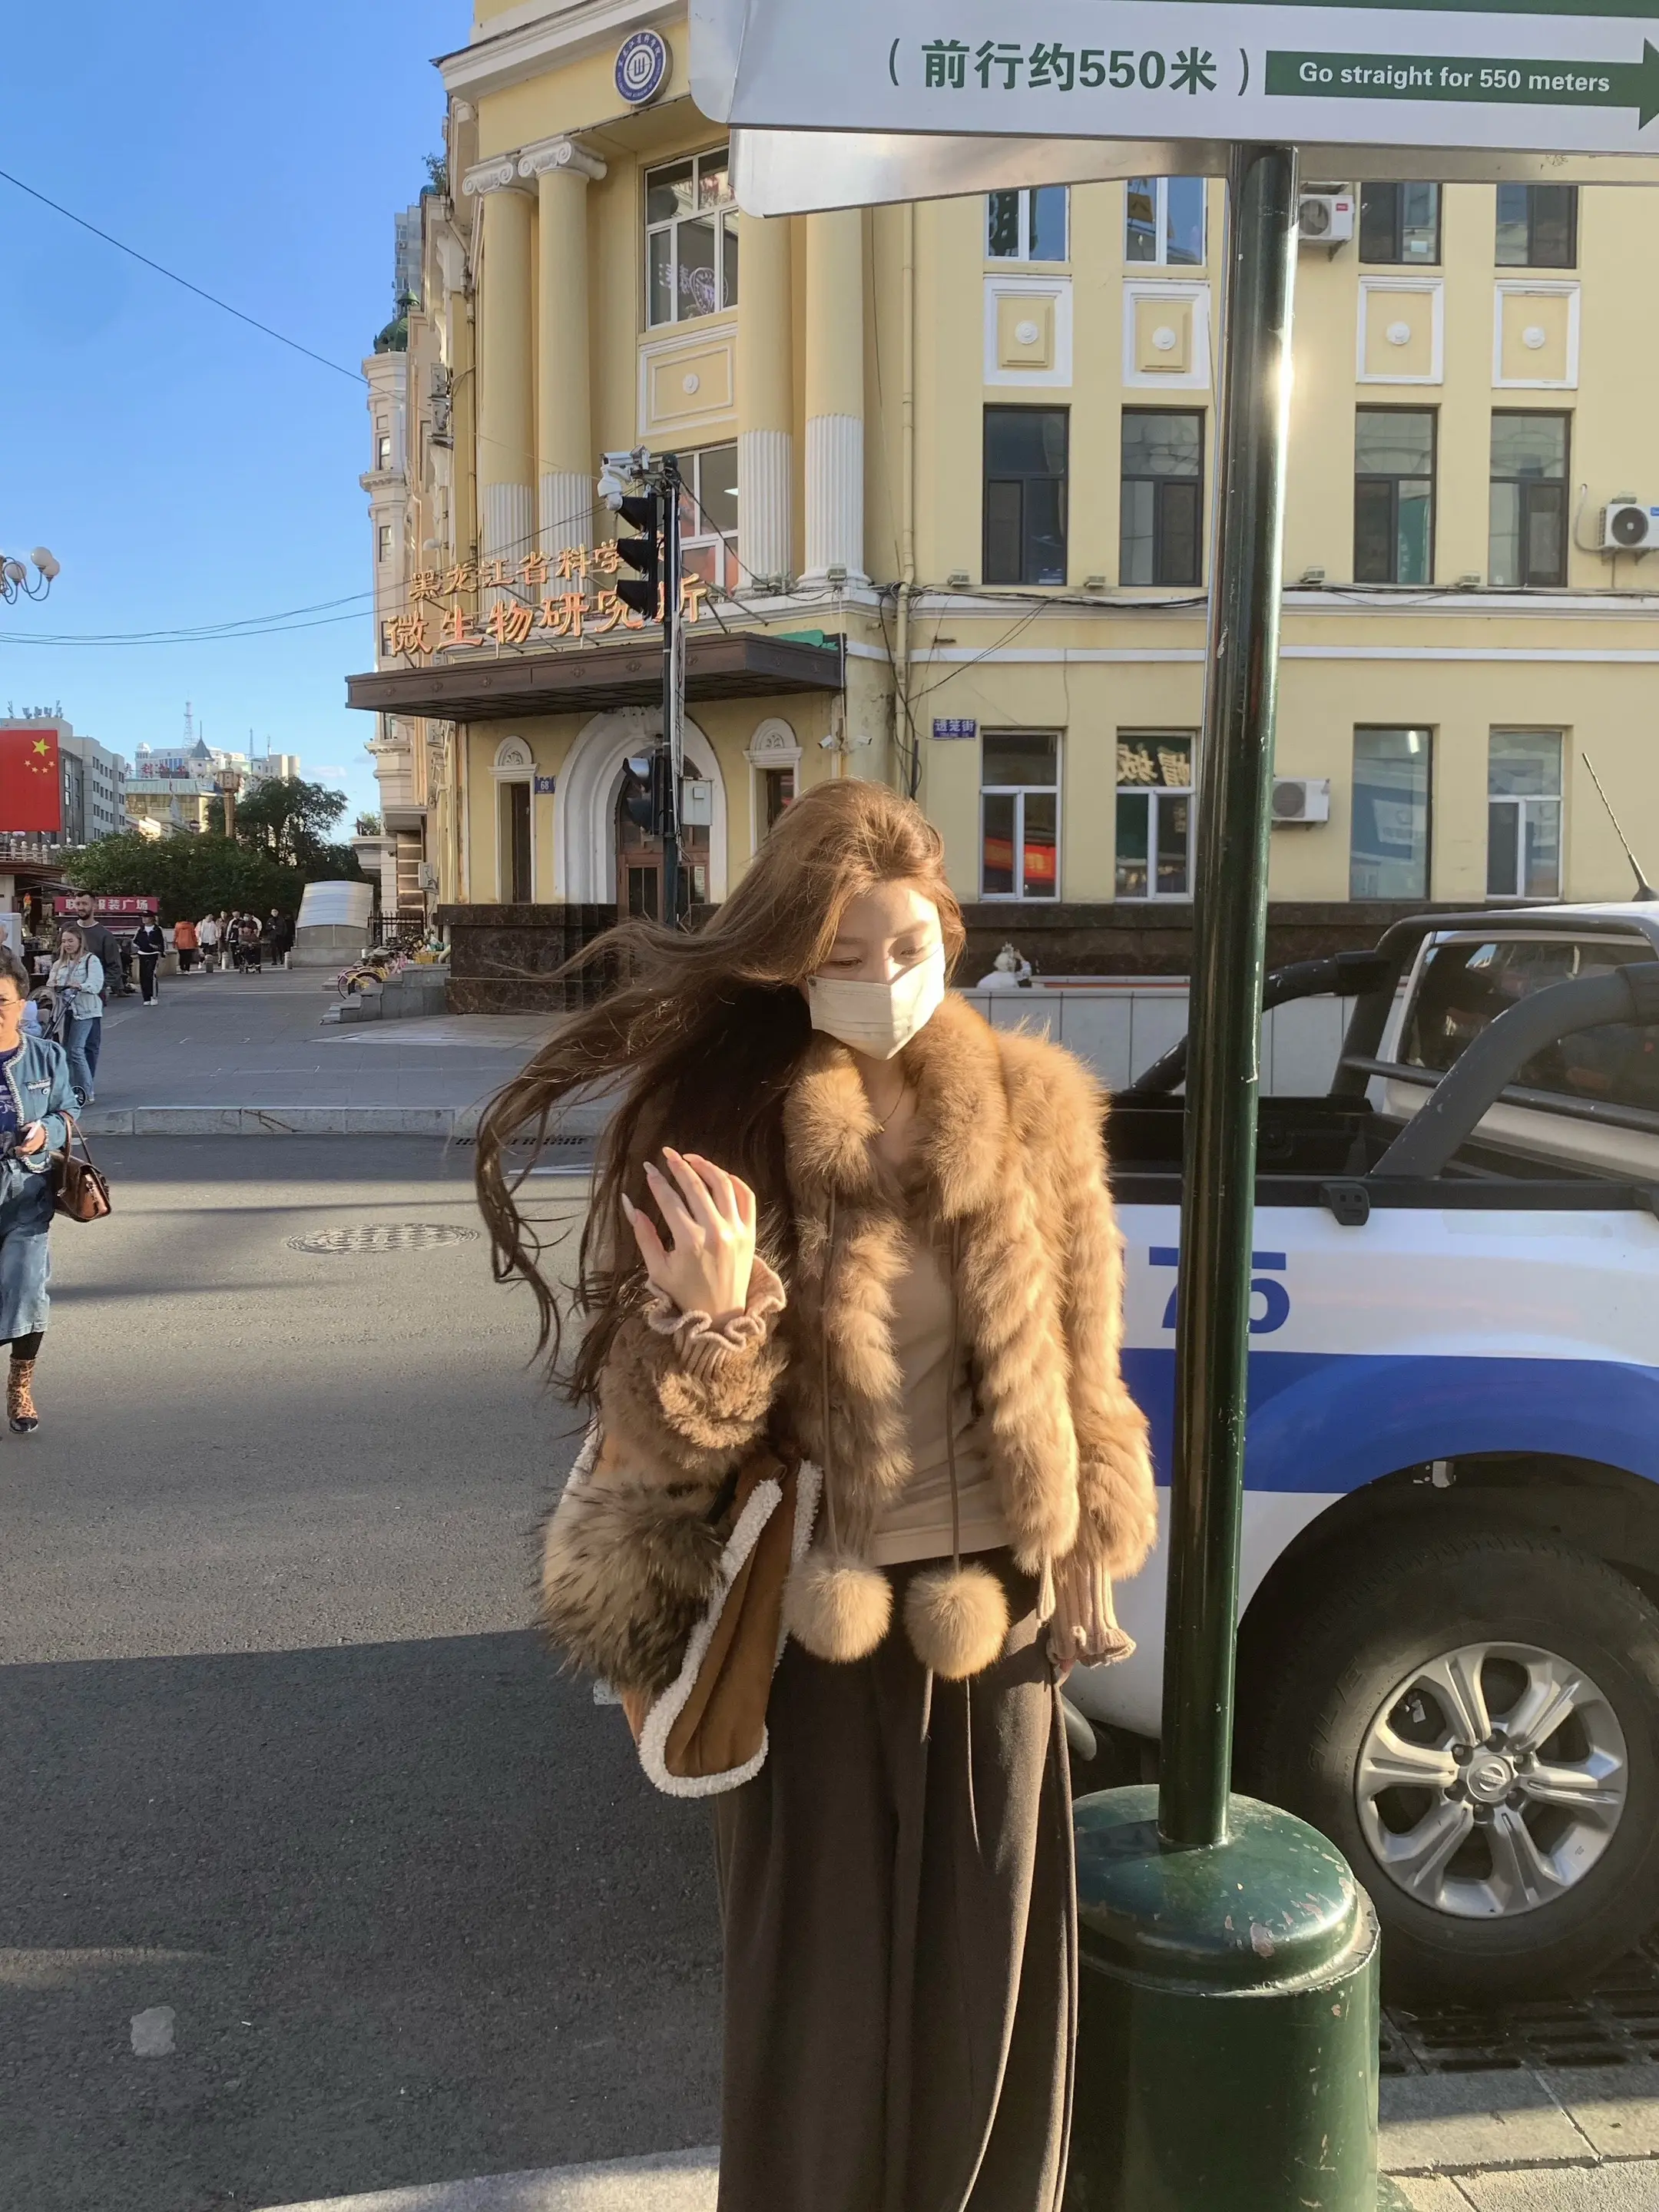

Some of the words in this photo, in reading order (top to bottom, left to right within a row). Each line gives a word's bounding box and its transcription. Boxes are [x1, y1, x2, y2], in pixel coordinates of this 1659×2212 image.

[1299, 61, 1334, 82] Go
[1340, 65, 1433, 90] straight
[1439, 66, 1474, 88] for
[1479, 68, 1522, 90] 550
[1528, 71, 1611, 93] meters
[409, 528, 665, 601] 黑龙江省科学
[65, 898, 148, 911] 联服装广场
